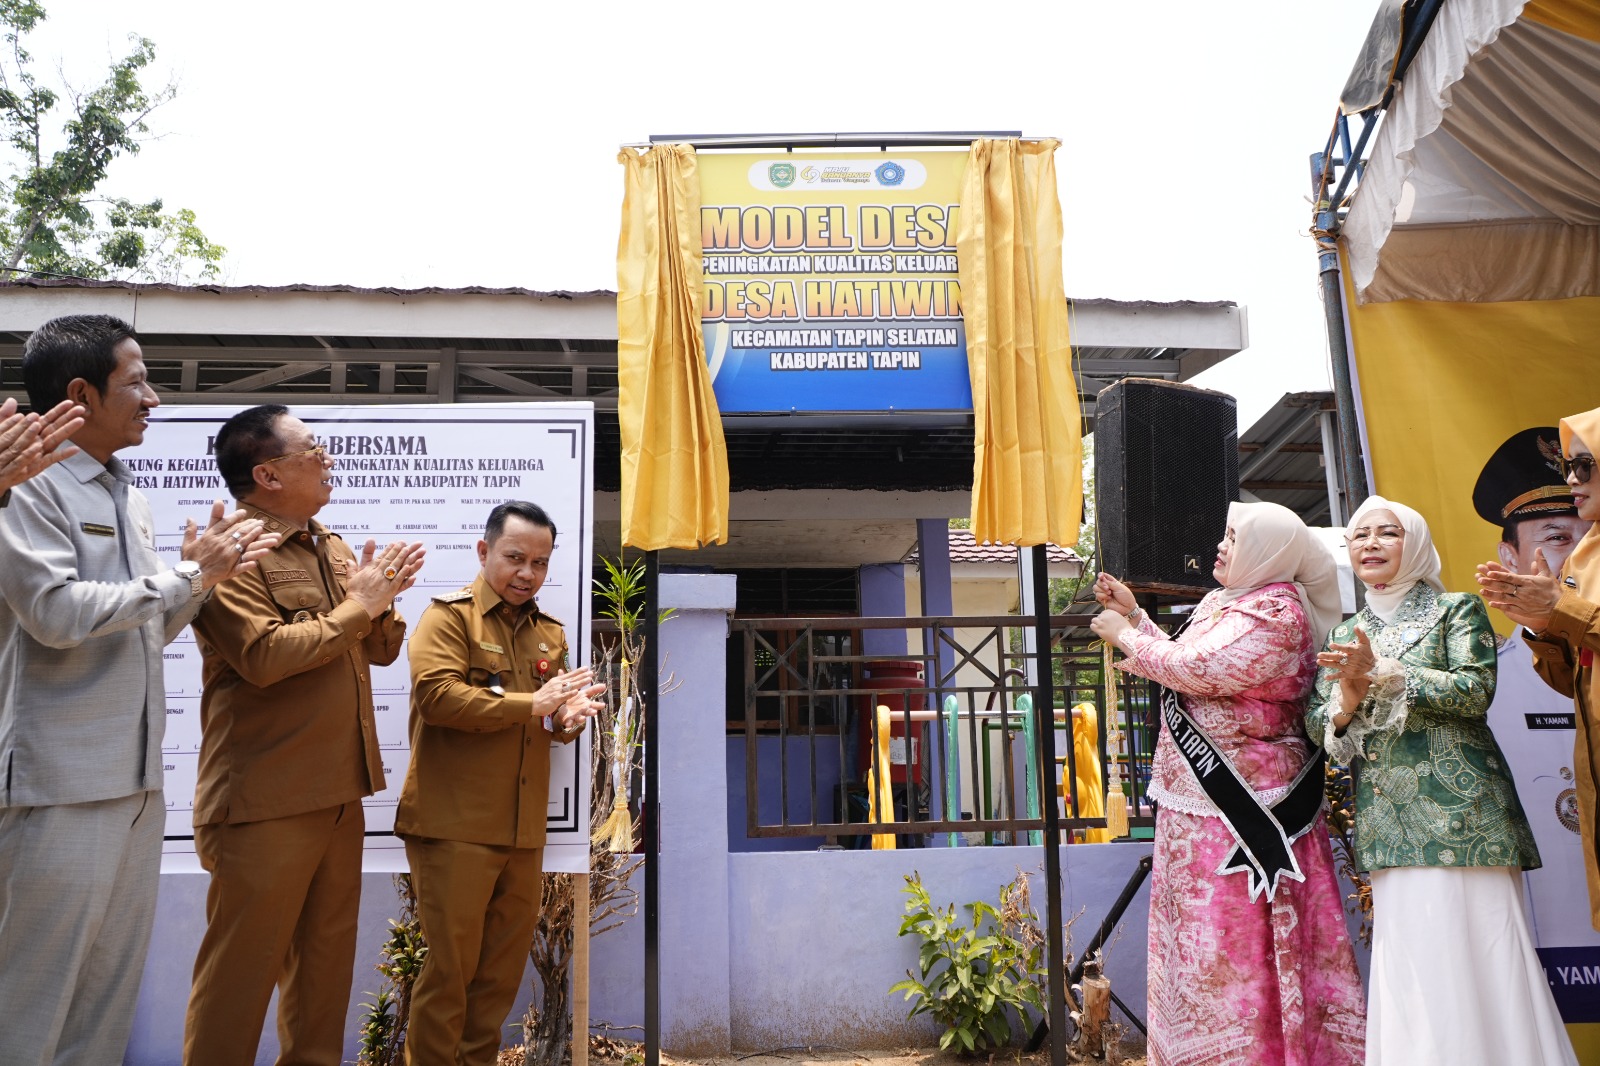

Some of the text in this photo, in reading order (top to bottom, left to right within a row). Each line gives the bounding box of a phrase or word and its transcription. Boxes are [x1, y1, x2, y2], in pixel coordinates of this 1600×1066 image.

[701, 206, 853, 251] MODEL
[702, 255, 958, 274] PENINGKATAN KUALITAS KELUAR
[702, 281, 798, 321] DESA
[731, 328, 958, 348] KECAMATAN TAPIN SELATAN
[770, 352, 920, 370] KABUPATEN TAPIN
[328, 435, 428, 456] BERSAMA
[167, 459, 220, 471] KEGIAT
[331, 458, 545, 471] ENINGKATAN KUALITAS KELUARGA
[162, 476, 220, 488] HATIWIN
[347, 476, 400, 488] SELATAN
[404, 475, 478, 488] KABUPATEN
[483, 475, 521, 488] TAPIN
[1179, 724, 1221, 779] TAPIN
[1556, 966, 1600, 985] YAM
